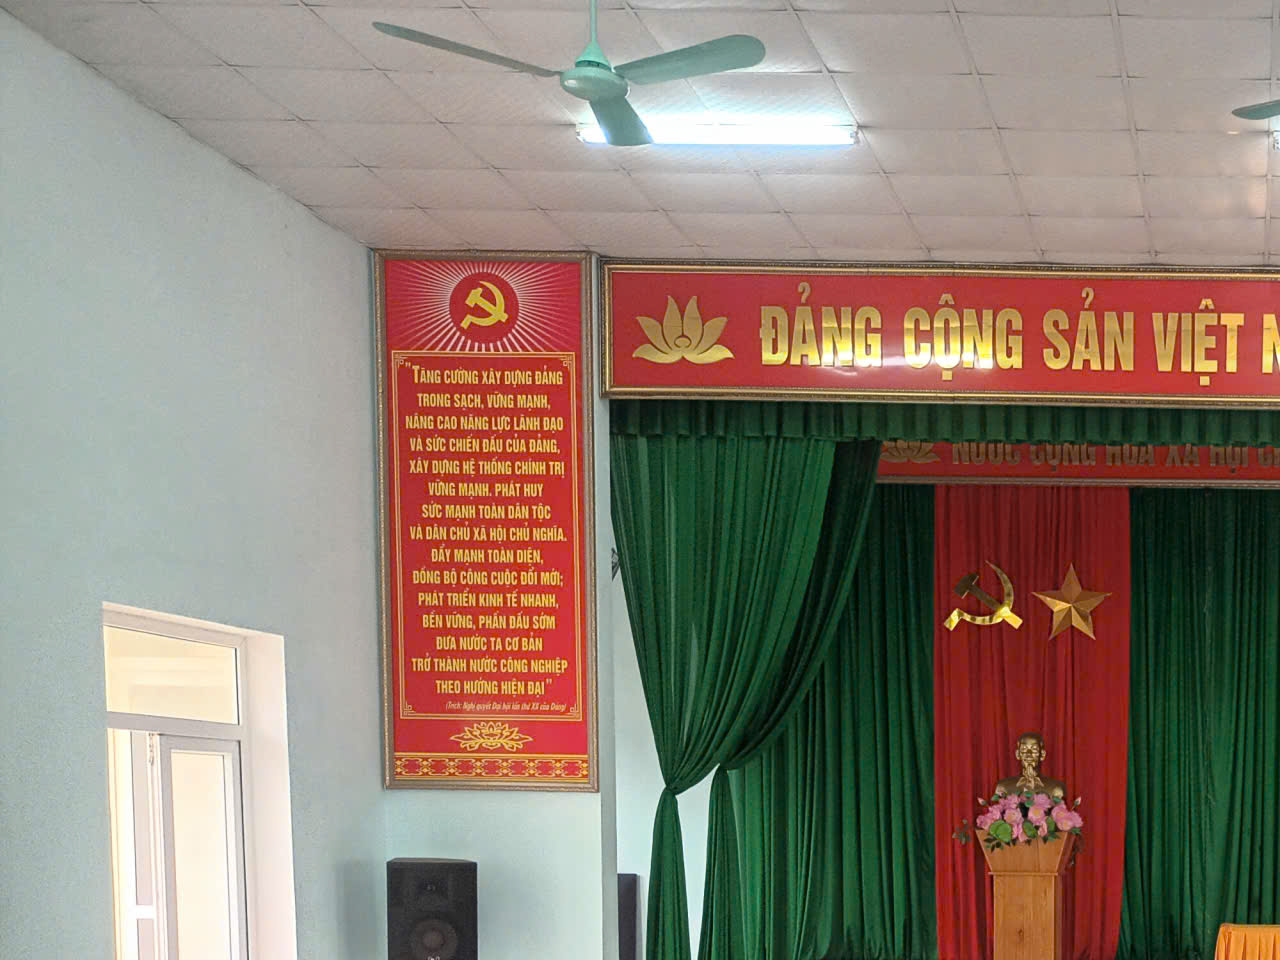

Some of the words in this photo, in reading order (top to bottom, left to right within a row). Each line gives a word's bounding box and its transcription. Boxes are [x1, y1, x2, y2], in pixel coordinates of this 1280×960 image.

[759, 282, 882, 368] ĐẢNG
[903, 293, 1023, 381] CỘNG
[1042, 287, 1135, 371] SẢN
[1151, 298, 1244, 386] VIỆT
[444, 367, 478, 384] CƯỜNG
[482, 368, 501, 384] XÂY
[504, 371, 532, 387] DỰNG
[535, 366, 562, 384] ĐẢNG
[418, 395, 450, 408] TRONG
[487, 392, 514, 408] VỮNG
[406, 414, 434, 430] NÂNG
[437, 417, 457, 430] CAO
[460, 414, 488, 430] NĂNG
[492, 416, 510, 432] LỰC
[514, 414, 540, 430] LÃNH
[543, 417, 563, 432] ĐẠO
[410, 436, 423, 451] VÀ
[426, 436, 446, 451] SỨC
[449, 434, 479, 451] CHIẾN
[482, 434, 502, 451] ĐẤU
[506, 434, 526, 451] CỦA
[410, 458, 428, 475] XÂY
[432, 461, 460, 477] DỰNG
[463, 458, 475, 477] HỆ
[478, 456, 512, 475] THỐNG
[515, 458, 546, 475] CHÍNH
[548, 461, 564, 477] TRỊ
[428, 481, 455, 496] VỮNG
[495, 481, 520, 496] PHÁT
[524, 484, 543, 496] HUY
[422, 502, 442, 518] SỨC
[446, 505, 476, 521] MẠNH
[478, 502, 505, 518] TOÀN
[508, 502, 529, 518] DÂN
[531, 502, 551, 521] TỘC
[410, 525, 423, 541] VÀ
[426, 525, 446, 541] DÂN
[450, 522, 470, 541] CHỦ
[474, 525, 487, 541] XÃ
[490, 525, 506, 543] HỘI
[510, 522, 530, 541] CHỦ
[432, 544, 450, 563] ĐẨY
[454, 549, 484, 566] MẠNH
[487, 546, 514, 563] TOÀN
[444, 568, 457, 587] BỘ
[460, 568, 488, 584] CÔNG
[491, 568, 517, 587] CUỘC
[418, 591, 442, 607] PHÁT
[479, 594, 503, 607] KINH
[506, 589, 517, 607] TẾ
[479, 610, 506, 628] PHẤN
[509, 610, 529, 628] ĐẤU
[533, 612, 555, 628] SỚM
[436, 636, 456, 651] ĐƯA
[460, 634, 487, 651] NƯỚC
[489, 637, 502, 651] TA
[505, 636, 519, 651] CƠ
[522, 631, 542, 651] BẢN
[412, 653, 430, 672] TRỞ
[433, 655, 466, 672] THÀNH
[470, 655, 497, 672] NƯỚC
[500, 655, 528, 672] CÔNG
[531, 655, 568, 675] NGHIỆP
[435, 680, 460, 694] THEO
[464, 677, 498, 694] HƯỚNG
[501, 677, 524, 697] HIỆN
